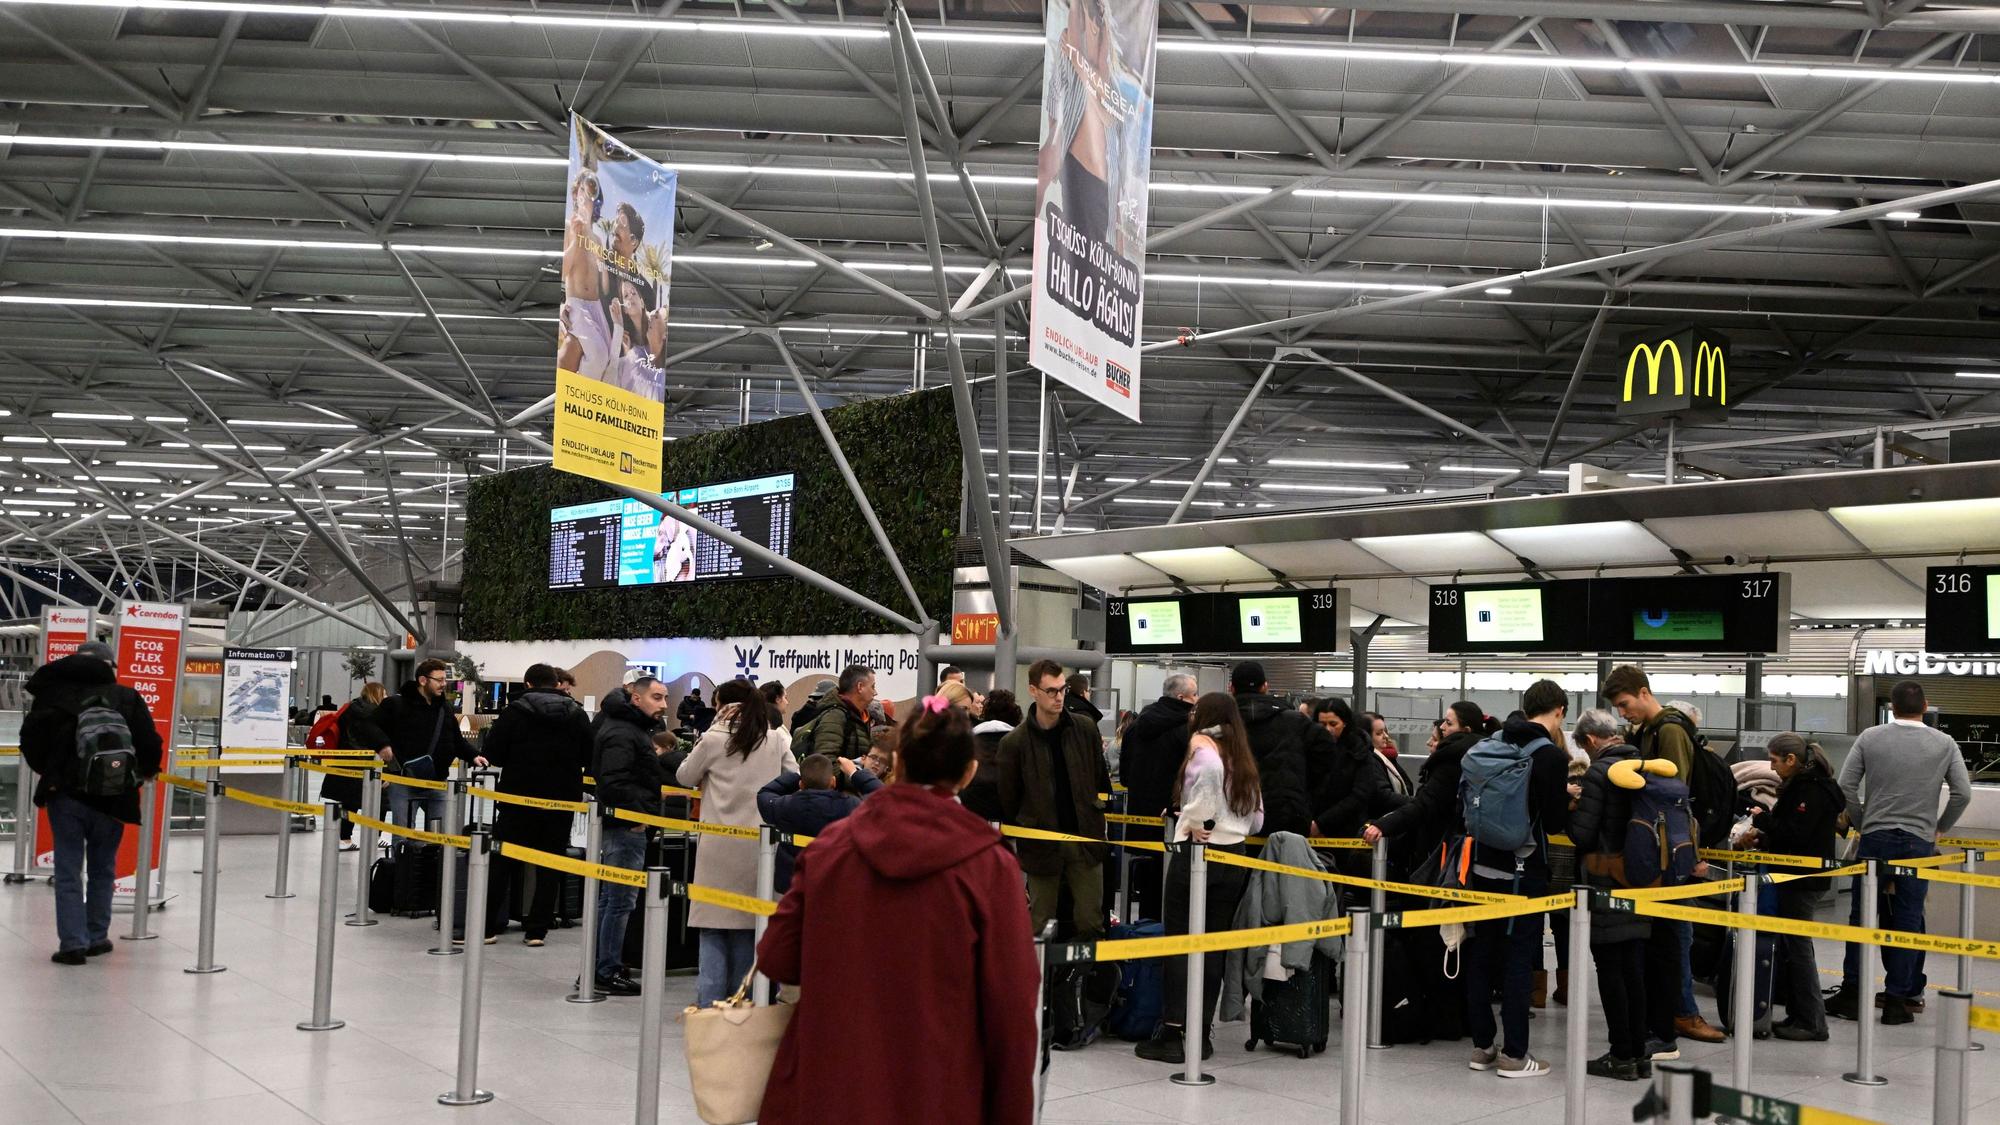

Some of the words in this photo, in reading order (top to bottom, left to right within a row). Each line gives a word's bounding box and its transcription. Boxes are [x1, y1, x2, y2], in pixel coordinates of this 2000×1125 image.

[1050, 212, 1087, 258] TSCHÜSS
[1050, 252, 1093, 311] HALLO
[1096, 276, 1133, 339] ÄGÄIS!
[1045, 327, 1073, 351] ENDLICH
[1074, 343, 1099, 367] URLAUB
[1106, 362, 1131, 390] BUCHER
[565, 385, 603, 405] TSCHÜSS
[605, 397, 650, 421] KÖLN-BONN.
[564, 402, 593, 420] HALLO
[595, 412, 659, 440] FAMILIENZEIT!
[561, 438, 589, 452] ENDLICH
[590, 447, 615, 459] URLAUB
[1742, 579, 1772, 599] 317
[1935, 573, 1971, 594] 316
[1311, 593, 1333, 609] 319
[1434, 590, 1458, 606] 318
[139, 609, 178, 620] corendon
[49, 643, 79, 652] PRIORIT
[134, 640, 164, 652] ECO&
[228, 650, 275, 659] Information
[135, 652, 161, 663] FLEX
[768, 649, 831, 674] Treffpunkt
[844, 649, 894, 676] Meeting
[899, 649, 919, 670] Poi
[1863, 650, 2000, 675] McDon
[130, 663, 165, 675] CLASS
[134, 681, 157, 692] BAG
[1487, 895, 1506, 903] Airport
[1894, 935, 1910, 943] Köln
[1933, 940, 1961, 950] Airport
